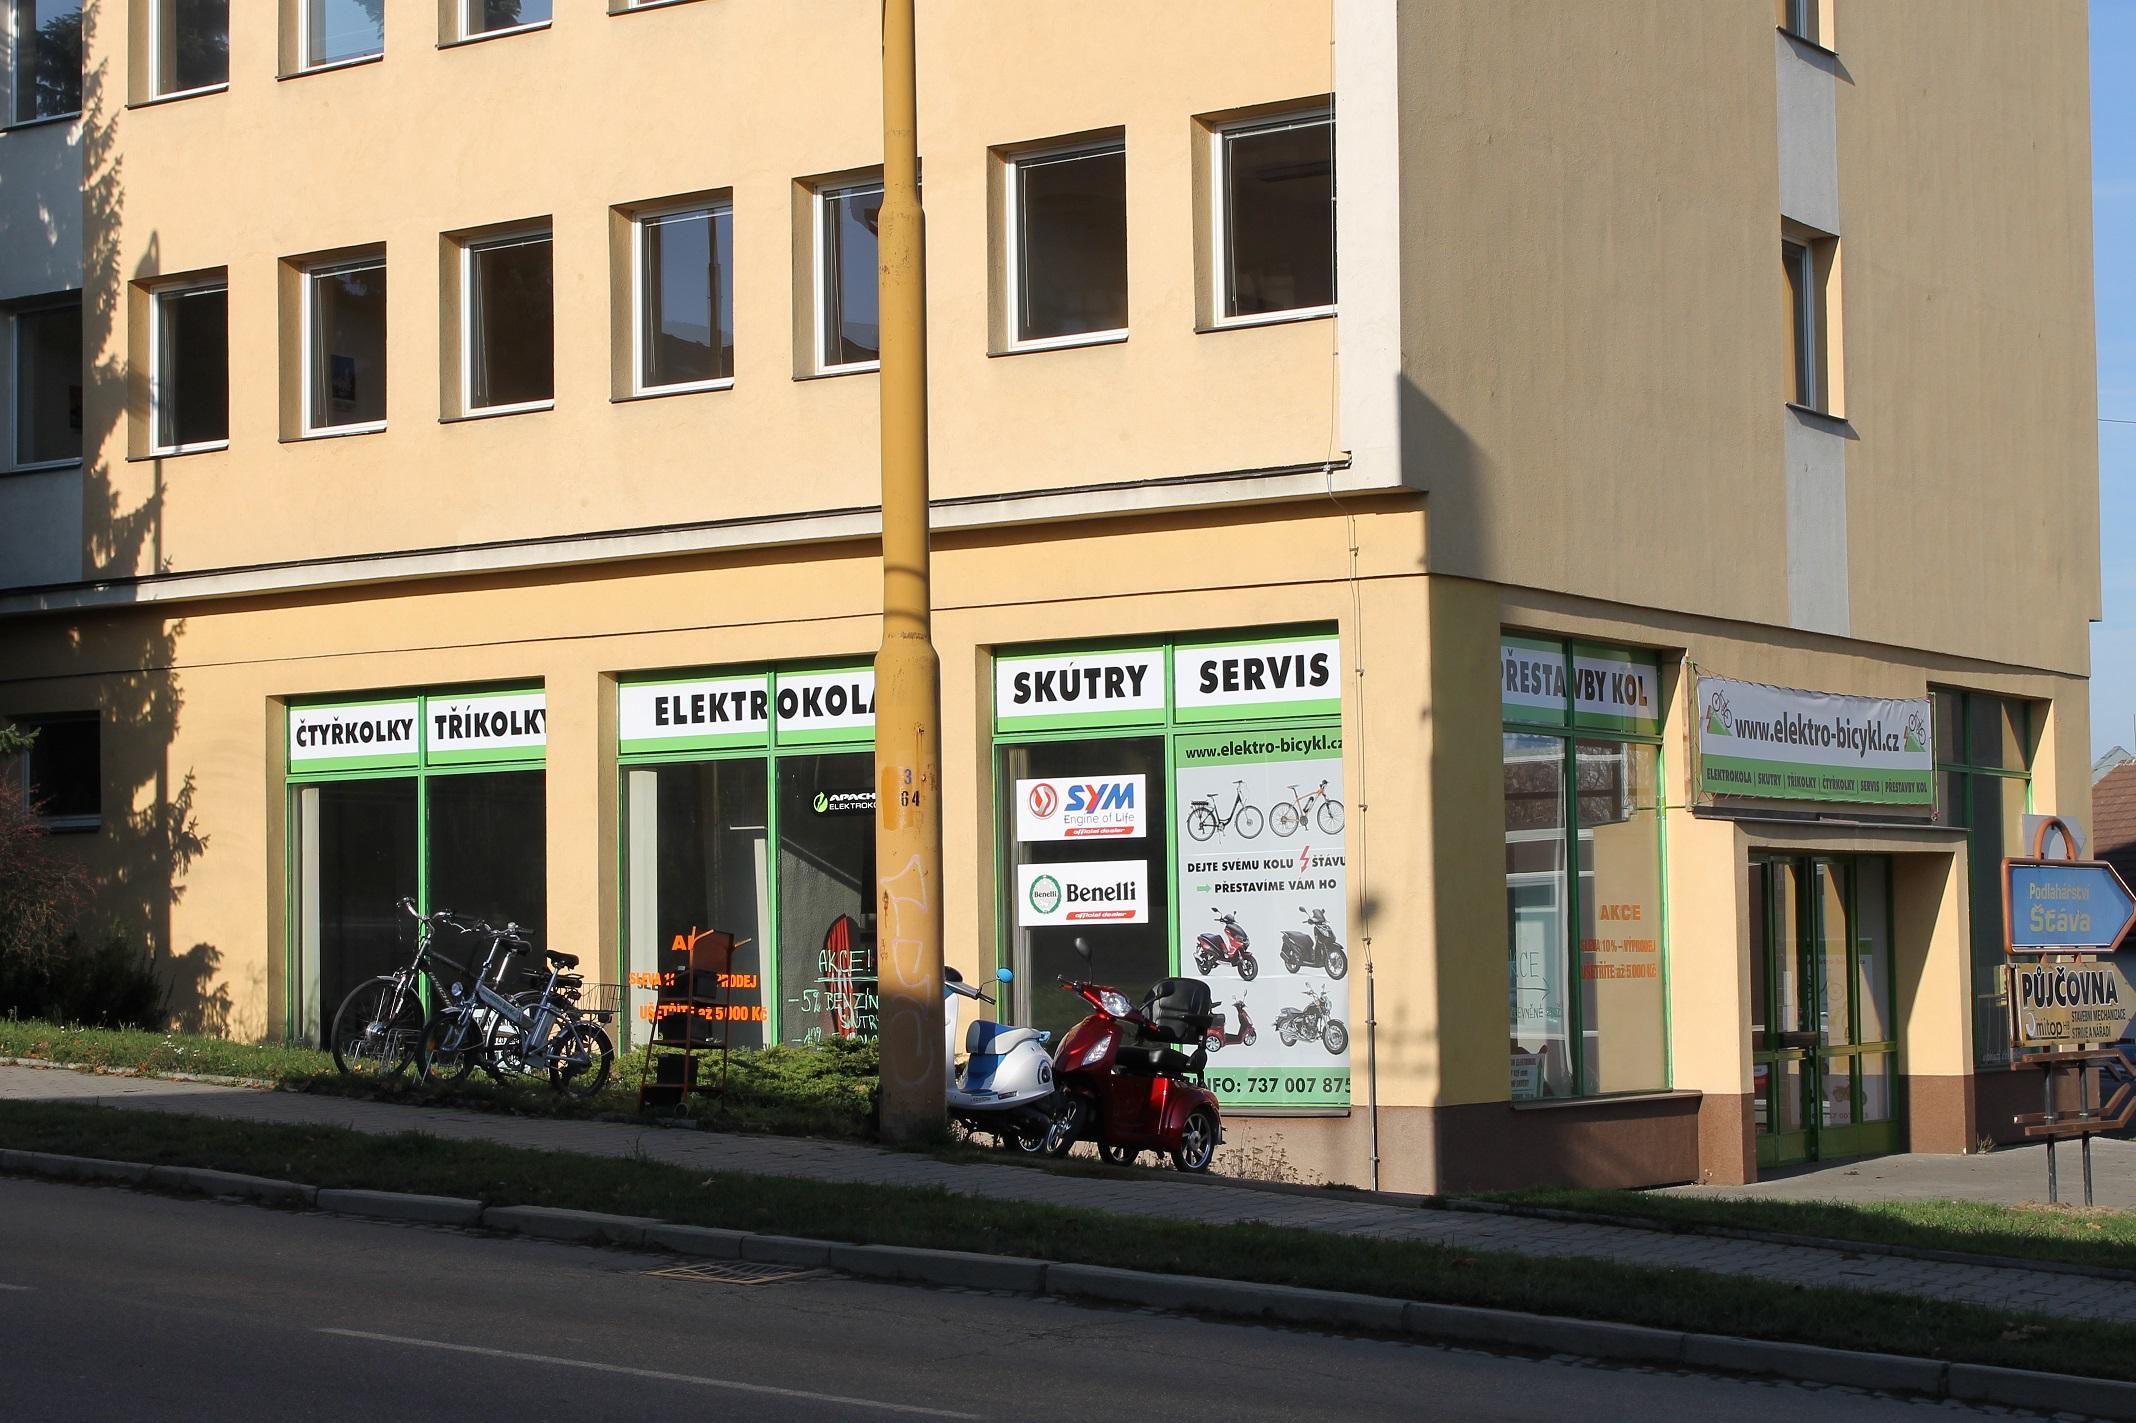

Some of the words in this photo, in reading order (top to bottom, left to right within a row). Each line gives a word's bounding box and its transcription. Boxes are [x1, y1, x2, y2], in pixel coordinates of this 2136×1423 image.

[1013, 662, 1149, 704] SKÚTRY
[1199, 653, 1329, 694] SERVIS
[1501, 648, 1606, 702] ŘESTAVBY
[1612, 672, 1648, 706] KOL
[296, 716, 413, 747] ČTYŘKOLKY
[1735, 712, 1900, 758] www.elektro-bicykl.cz
[903, 768, 912, 785] 3
[1706, 768, 1752, 784] ELEKTROKOLA
[1860, 780, 1880, 792] SERVIS
[1916, 781, 1928, 793] KOL
[829, 793, 876, 801] APACH
[1064, 782, 1134, 814] SYM
[1064, 813, 1099, 826] Engine
[1102, 812, 1112, 823] of
[1115, 812, 1135, 824] Life
[1187, 861, 1218, 872] DEJTE
[1222, 858, 1260, 871] SVÉMU
[1263, 859, 1294, 870] KOLU
[1034, 890, 1057, 898] Benelli
[1066, 881, 1136, 903] Benelli
[1214, 879, 1285, 893] PŘESTAVÍME
[1288, 877, 1315, 891] VÁM
[1319, 878, 1337, 889] HO
[1600, 904, 1641, 921] AKCE
[818, 949, 871, 975] AKCE!
[2022, 966, 2119, 1008] PŮJČOVNA
[752, 1005, 768, 1021] Kč
[2093, 1008, 2126, 1021] MECHANIZACE
[1247, 1077, 1279, 1093] 737
[1284, 1077, 1317, 1093] 007
